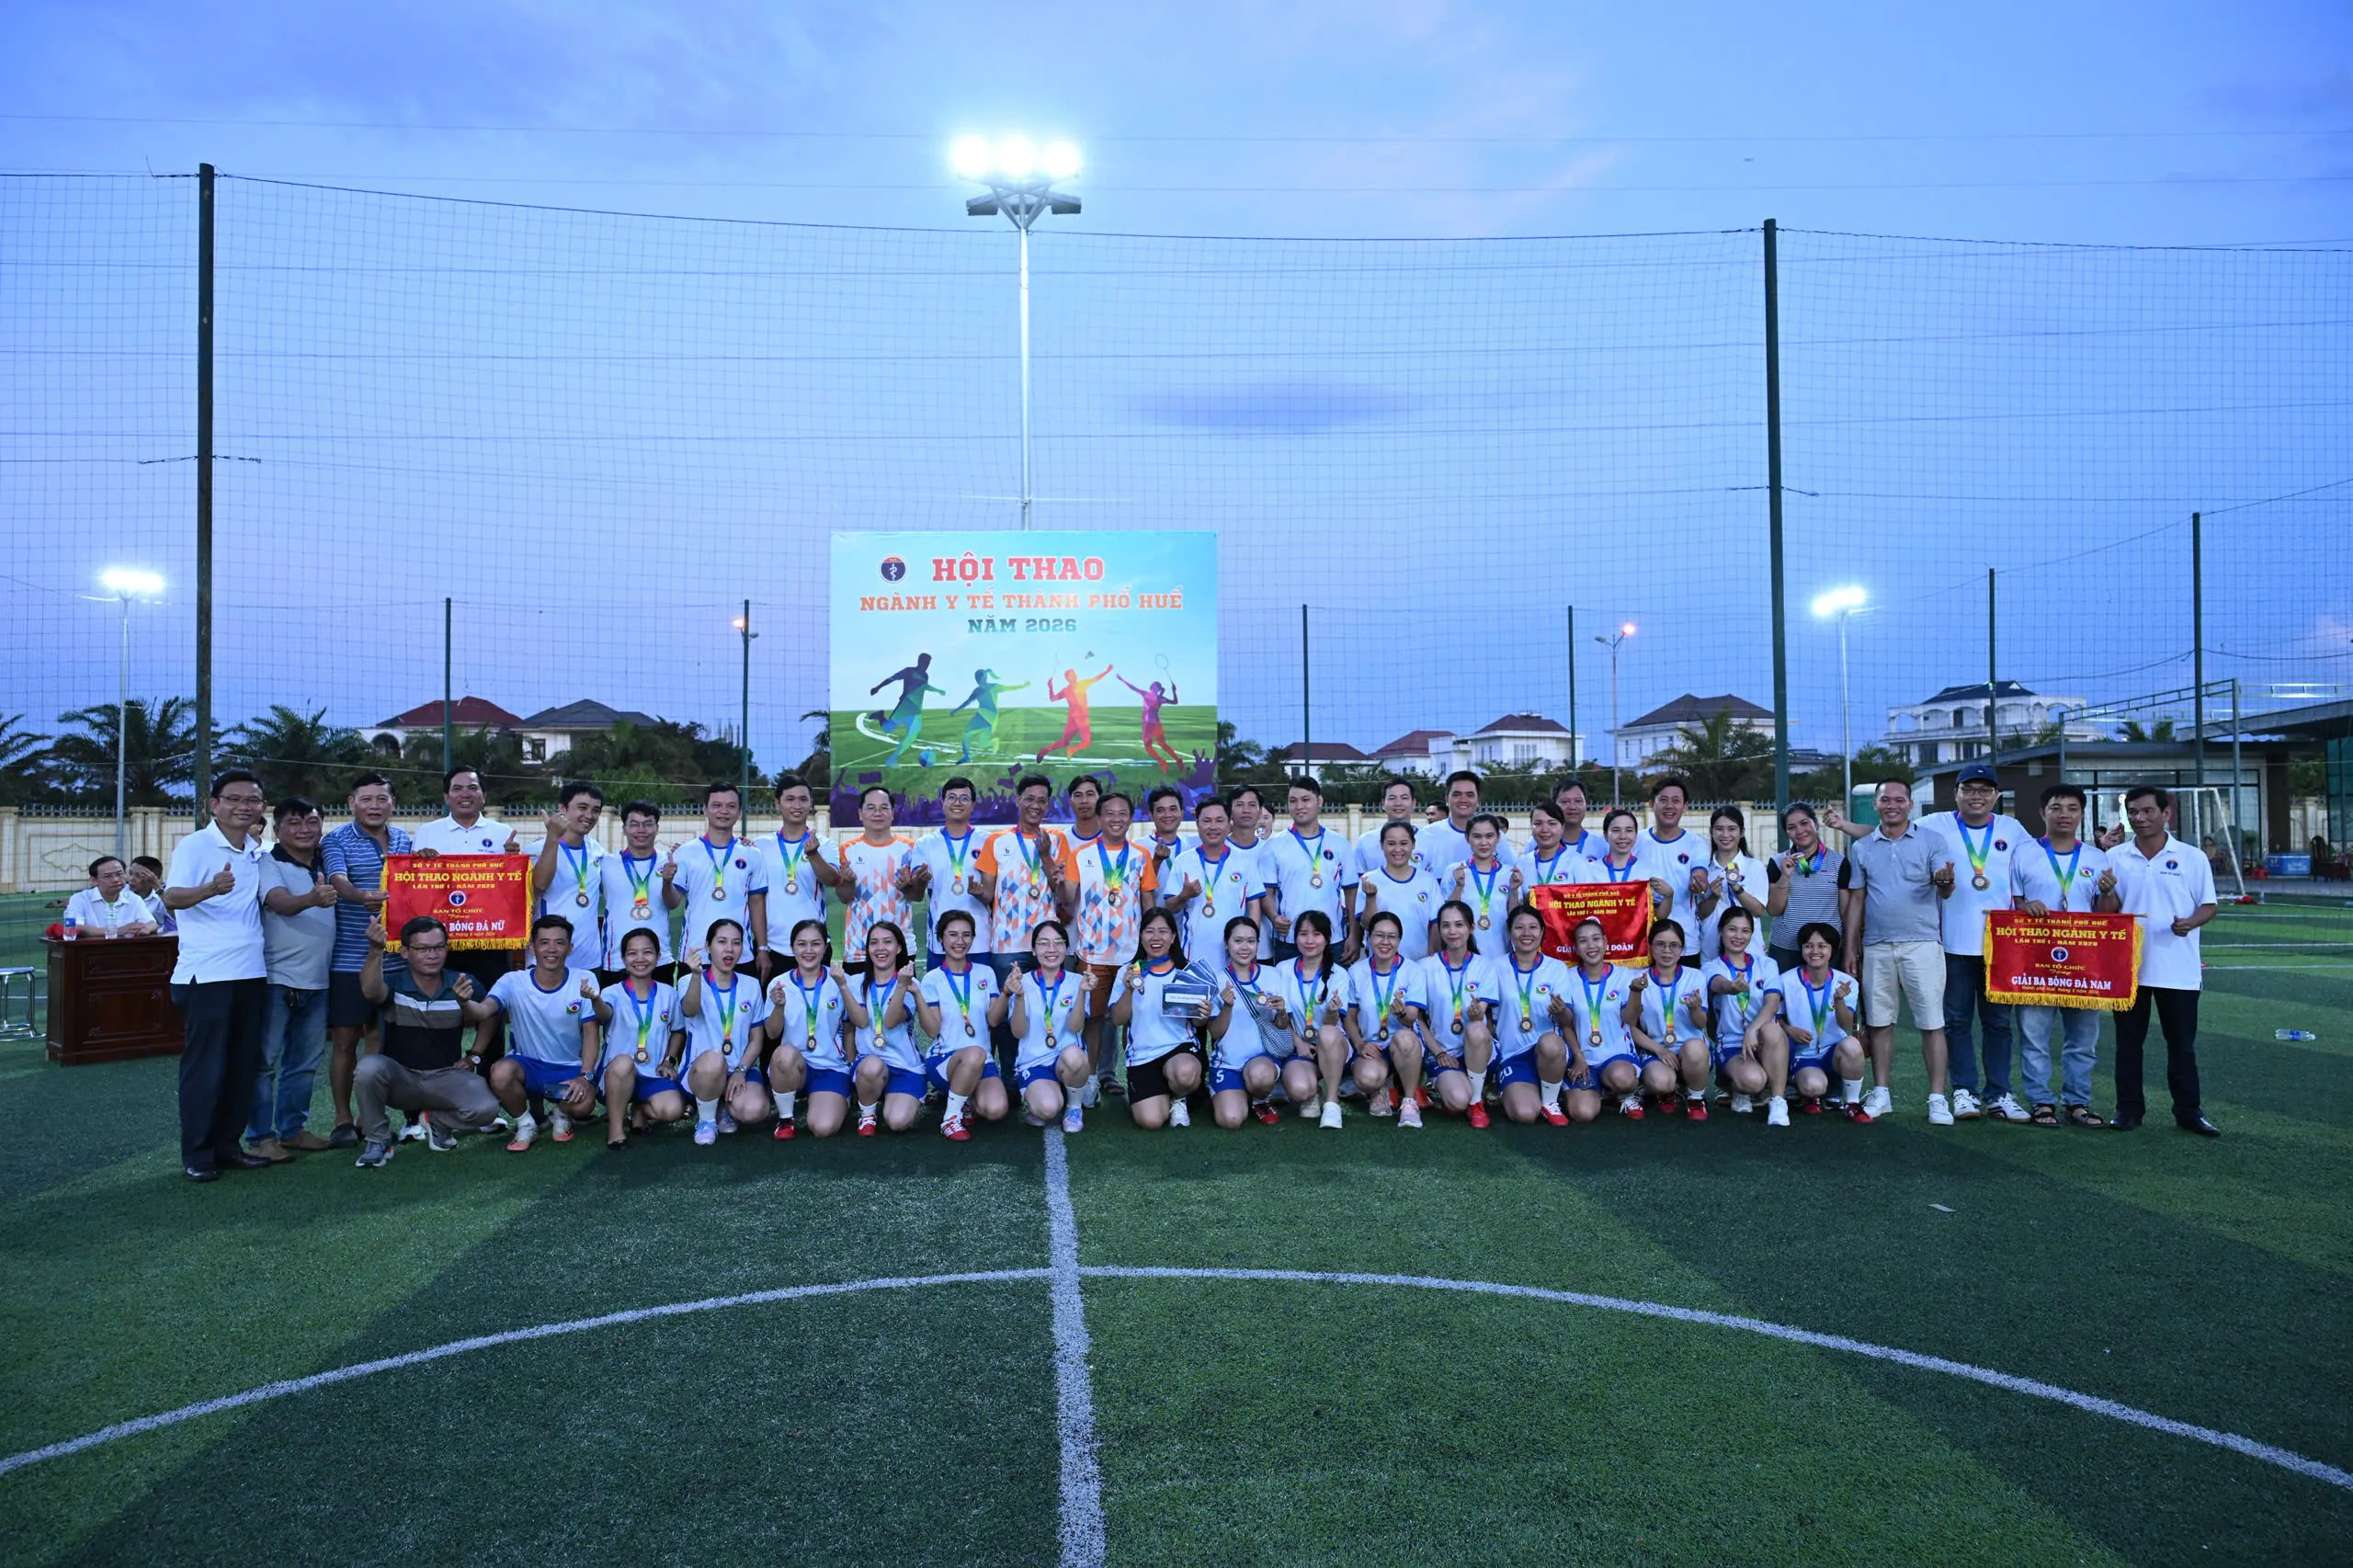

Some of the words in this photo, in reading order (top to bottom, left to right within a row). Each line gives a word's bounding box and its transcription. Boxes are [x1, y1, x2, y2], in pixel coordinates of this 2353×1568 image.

[933, 551, 994, 586] HỘI
[1008, 557, 1104, 581] THAO
[859, 592, 937, 610] NGÀNH
[945, 596, 960, 609] Y
[967, 586, 995, 609] TẾ
[1003, 590, 1079, 609] THÀNH
[1087, 586, 1131, 608] PHỐ
[1139, 585, 1184, 609] HUẾ
[967, 614, 1016, 633] NĂM
[1026, 619, 1076, 632] 2026
[394, 871, 415, 883] HỘI
[418, 873, 450, 881] THAO
[452, 871, 494, 881] NGÀNH
[496, 873, 505, 881] Y
[507, 869, 522, 881] TẾ
[1549, 901, 1562, 910] HỘI
[1625, 897, 1636, 906] TẾ
[449, 920, 474, 932] BÓNG
[476, 920, 488, 931] ĐÁ
[492, 920, 505, 931] NỮ
[1996, 926, 2017, 937] HỘI
[2020, 928, 2050, 937] THAO
[2052, 927, 2097, 938] NGÀNH
[2098, 931, 2108, 939] Y
[2110, 928, 2126, 940] TẾ
[2011, 973, 2032, 985] GIẢI
[2034, 977, 2046, 986] BA
[2048, 976, 2073, 987] BÓNG
[2075, 978, 2088, 989] ĐÁ
[2090, 980, 2111, 990] NAM
